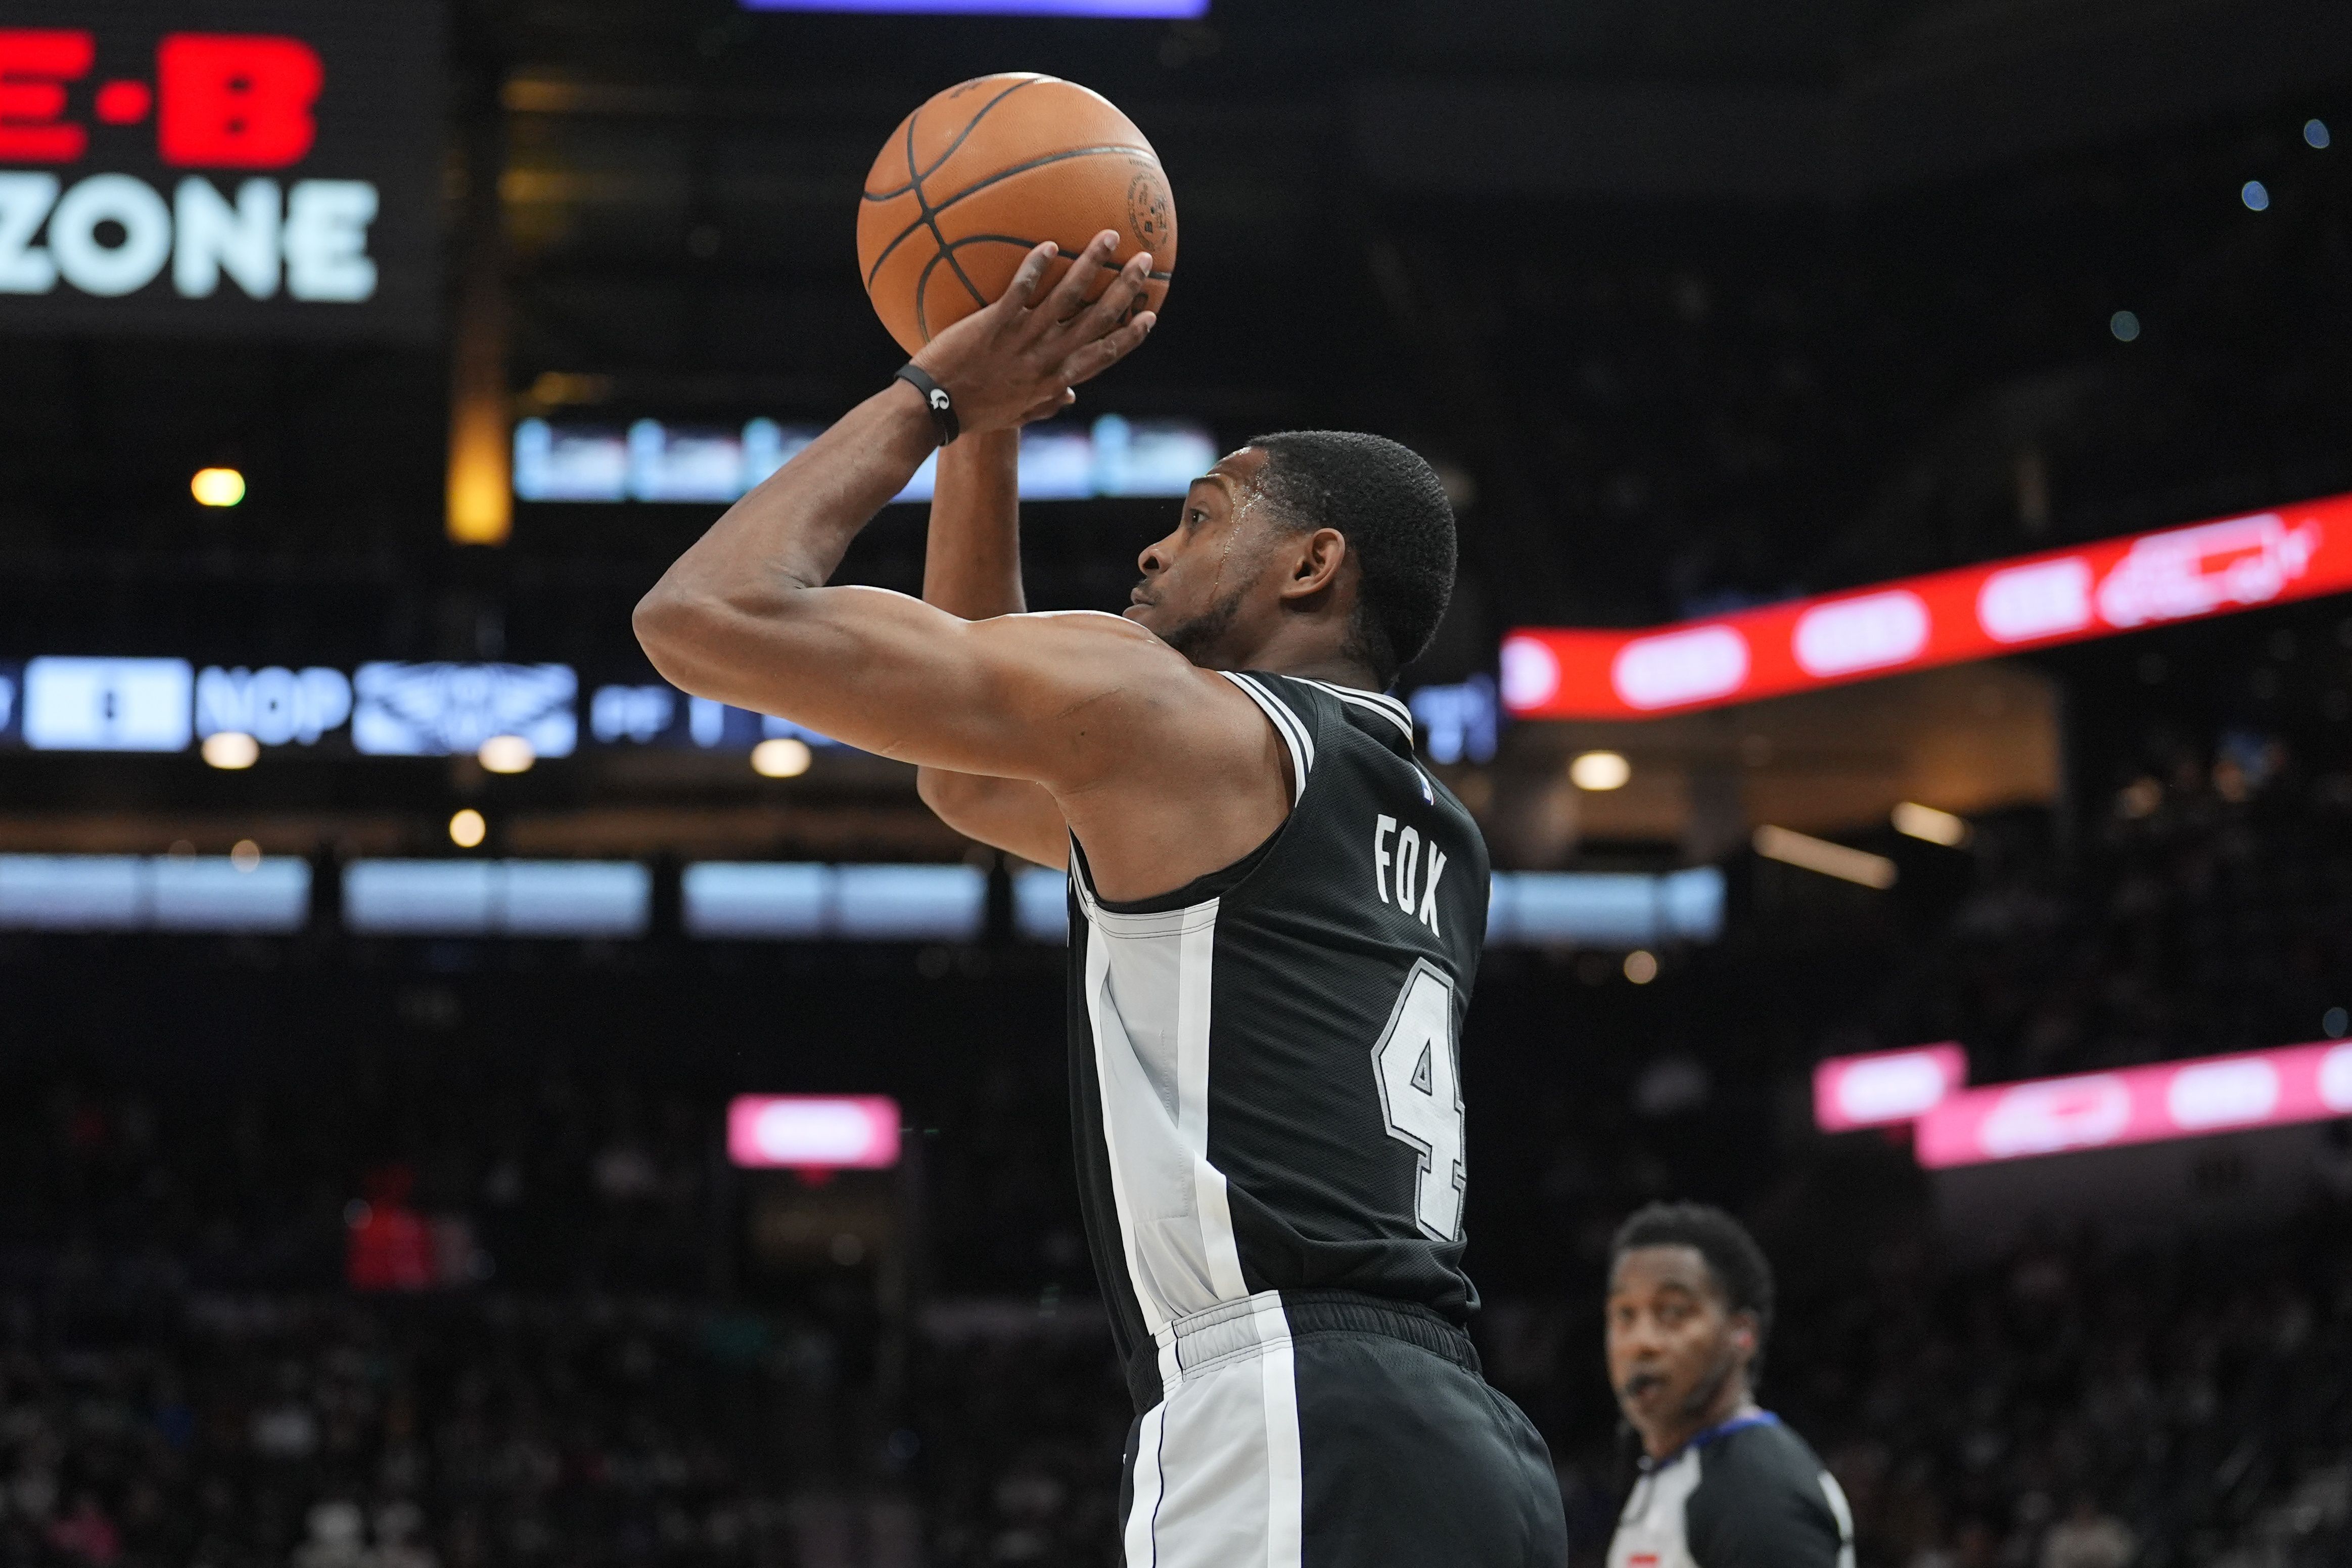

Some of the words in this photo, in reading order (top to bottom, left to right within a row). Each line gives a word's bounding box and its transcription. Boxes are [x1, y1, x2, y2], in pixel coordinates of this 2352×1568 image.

[0, 171, 380, 302] ZONE
[196, 666, 353, 746] NOP
[1374, 813, 1447, 938] FOX
[1370, 957, 1466, 1242] 4
